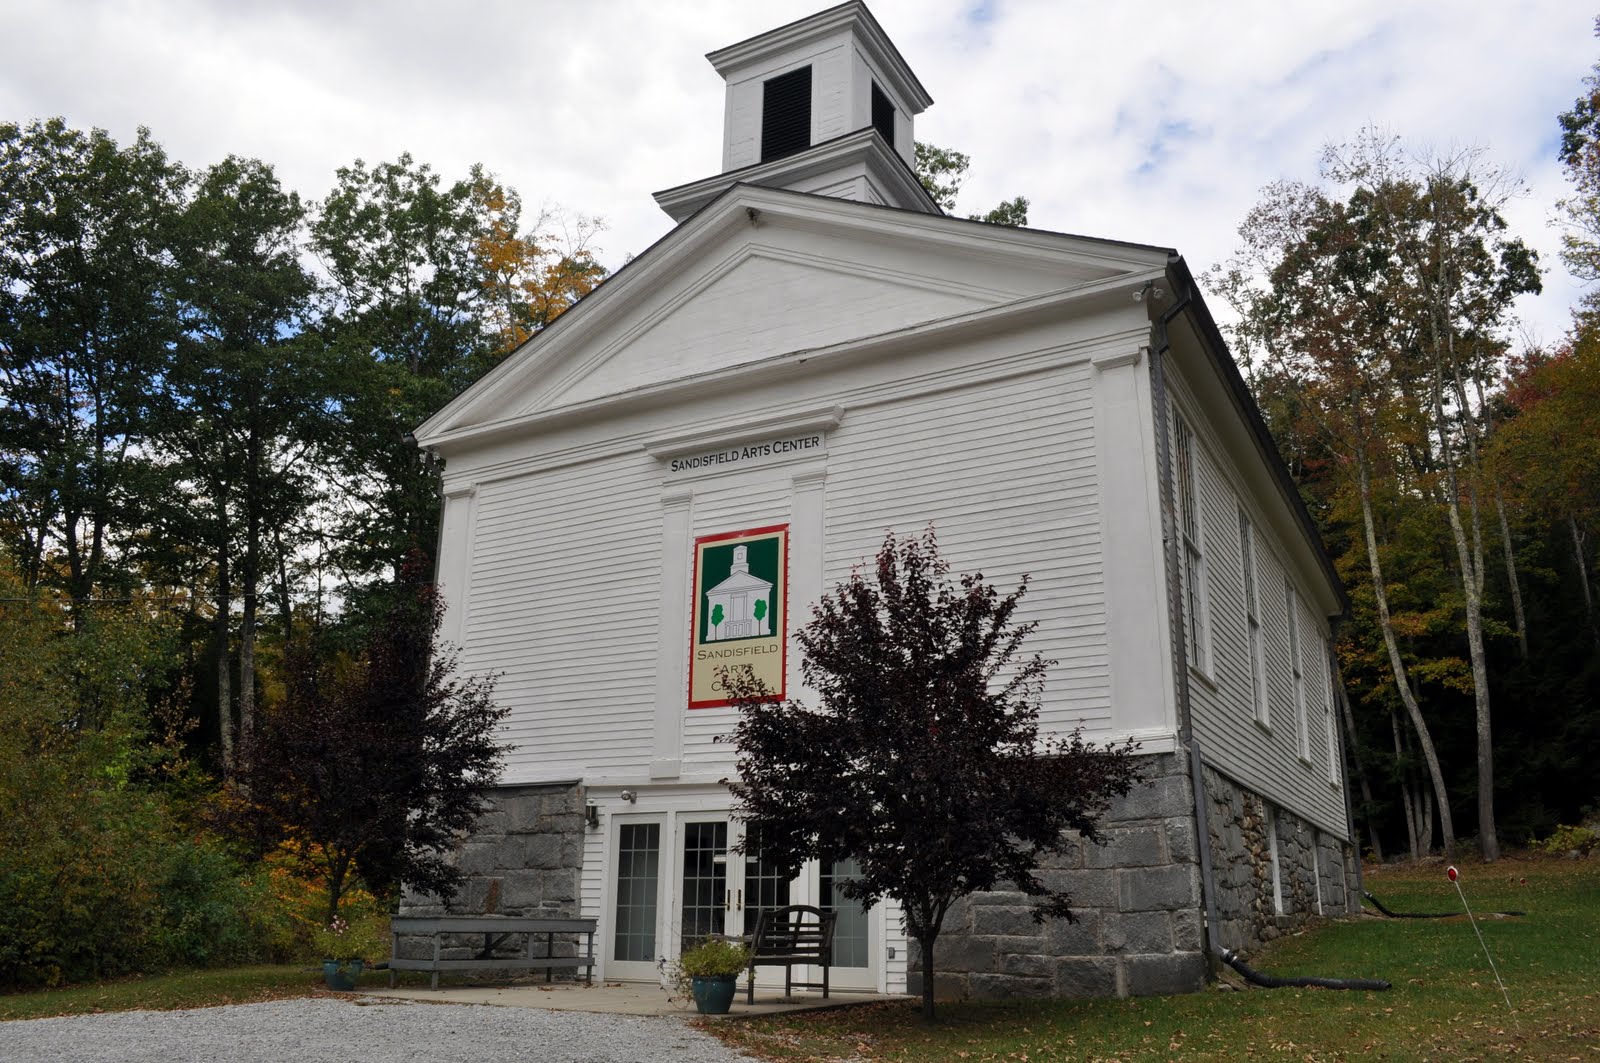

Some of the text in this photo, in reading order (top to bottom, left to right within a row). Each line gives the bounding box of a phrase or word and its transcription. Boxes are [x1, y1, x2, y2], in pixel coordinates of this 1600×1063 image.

[671, 436, 819, 472] SANDISFIELD ARTS CENTER
[697, 644, 778, 660] SANDISFIELD
